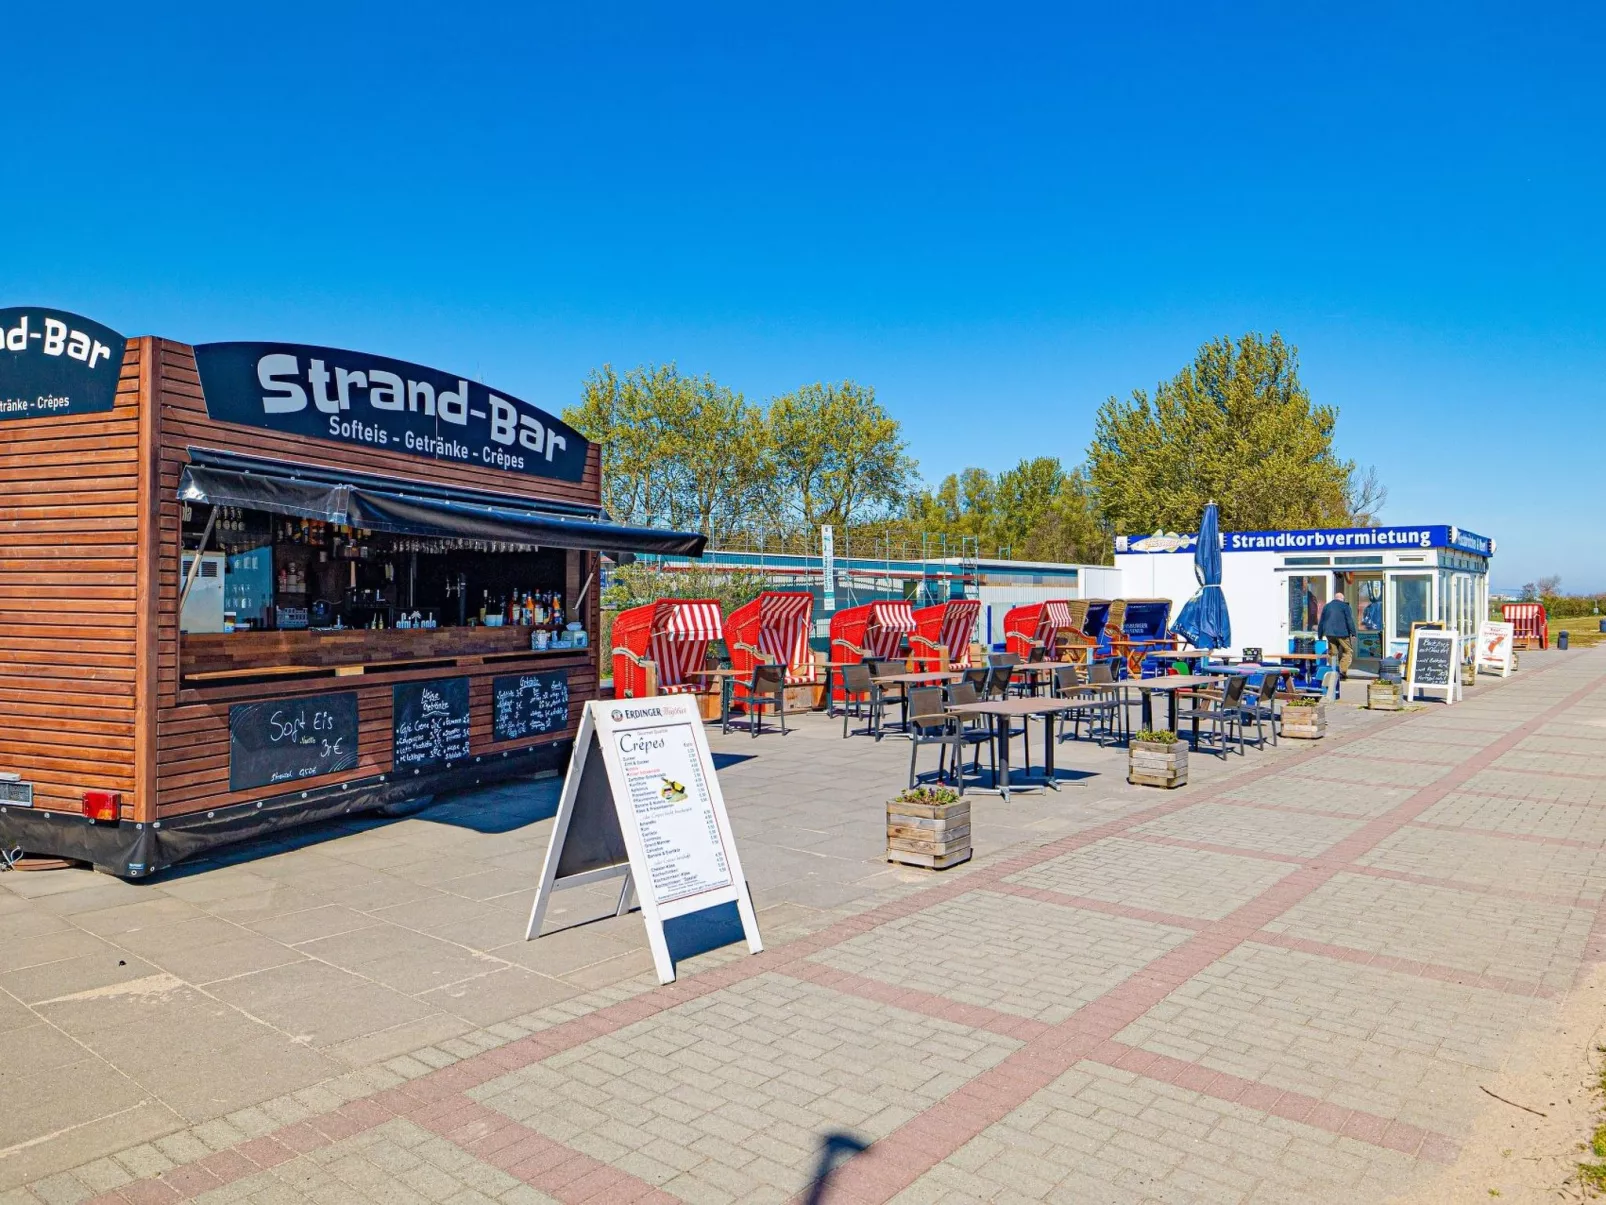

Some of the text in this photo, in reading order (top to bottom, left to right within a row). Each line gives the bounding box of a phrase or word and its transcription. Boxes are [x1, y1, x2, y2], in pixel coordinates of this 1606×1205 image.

[0, 316, 111, 369] d-Bar
[37, 394, 70, 411] Crêpes
[257, 353, 567, 462] Strand-Bar
[329, 416, 388, 444] Softeis
[404, 431, 469, 460] Getränke
[482, 446, 525, 471] Crêpes
[1232, 529, 1431, 549] Strandkorbvermietung
[624, 707, 663, 720] ERDINGER
[619, 733, 665, 754] Crêpes
